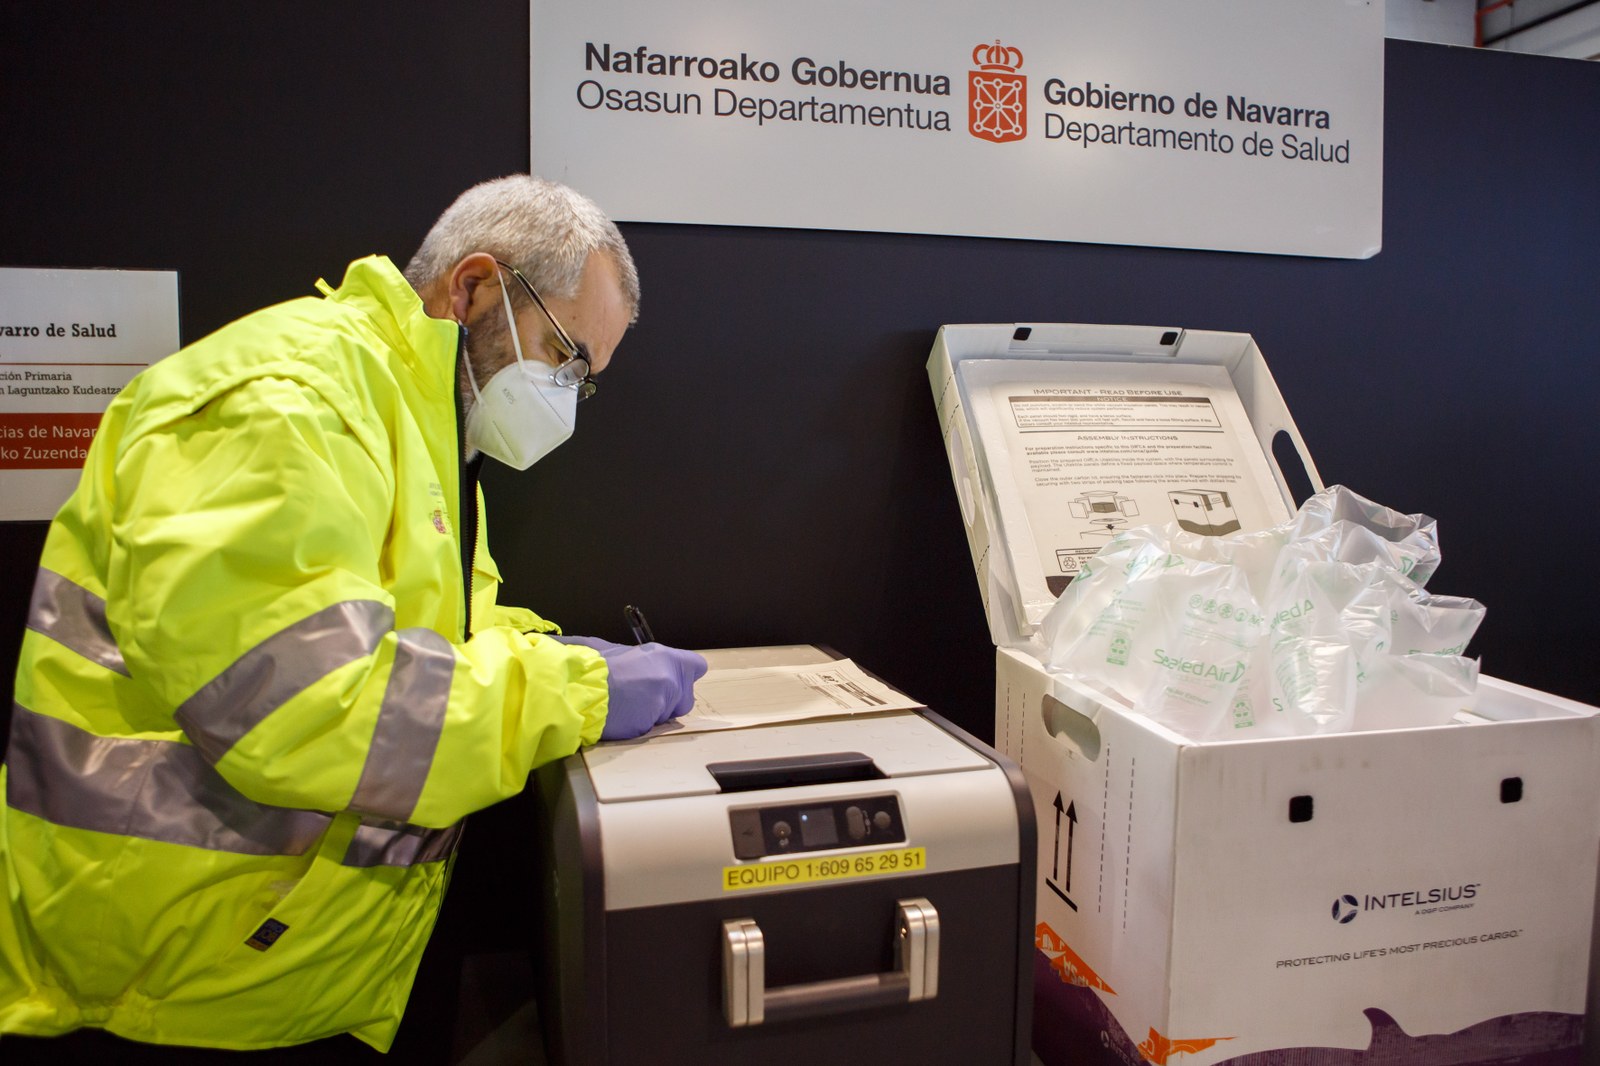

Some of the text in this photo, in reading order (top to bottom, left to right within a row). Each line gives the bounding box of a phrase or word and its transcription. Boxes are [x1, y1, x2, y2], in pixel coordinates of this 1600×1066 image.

[584, 41, 952, 97] Nafarroako Gobernua
[576, 79, 952, 132] Osasun Departamentua
[1043, 77, 1331, 130] Gobierno de Navarra
[1044, 112, 1350, 164] Departamento de Salud
[46, 323, 66, 338] de
[71, 323, 117, 338] Salud
[7, 385, 70, 397] Laguntzako
[73, 385, 125, 395] Kudeatza
[25, 371, 72, 381] Primaria
[28, 425, 48, 439] de
[727, 851, 922, 887] EQUIPO 1:609 65 29 51
[1438, 902, 1475, 913] COMPANY
[1275, 952, 1352, 969] PROTECTING
[1352, 947, 1388, 961] LIFE'S
[1389, 942, 1422, 955] MOST
[1422, 934, 1478, 952] PRECIOUS
